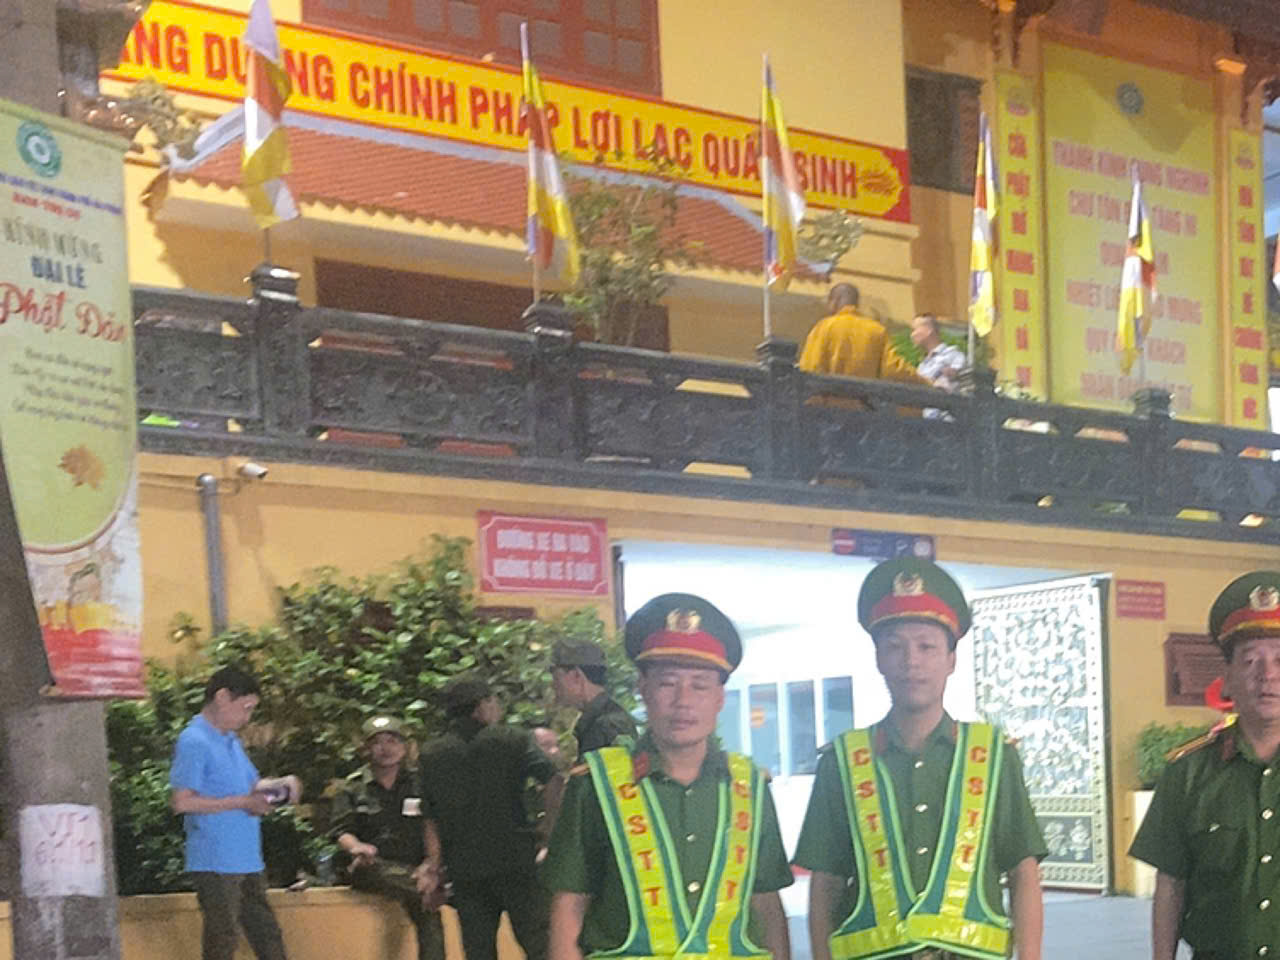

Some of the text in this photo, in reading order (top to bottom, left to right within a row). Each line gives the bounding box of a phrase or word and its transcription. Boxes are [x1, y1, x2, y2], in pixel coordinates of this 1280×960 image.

[350, 60, 459, 126] CHÍNH
[619, 781, 662, 907] CSTT
[725, 779, 750, 901] CSTT
[852, 747, 887, 869] CSTT
[961, 745, 988, 864] CSTT
